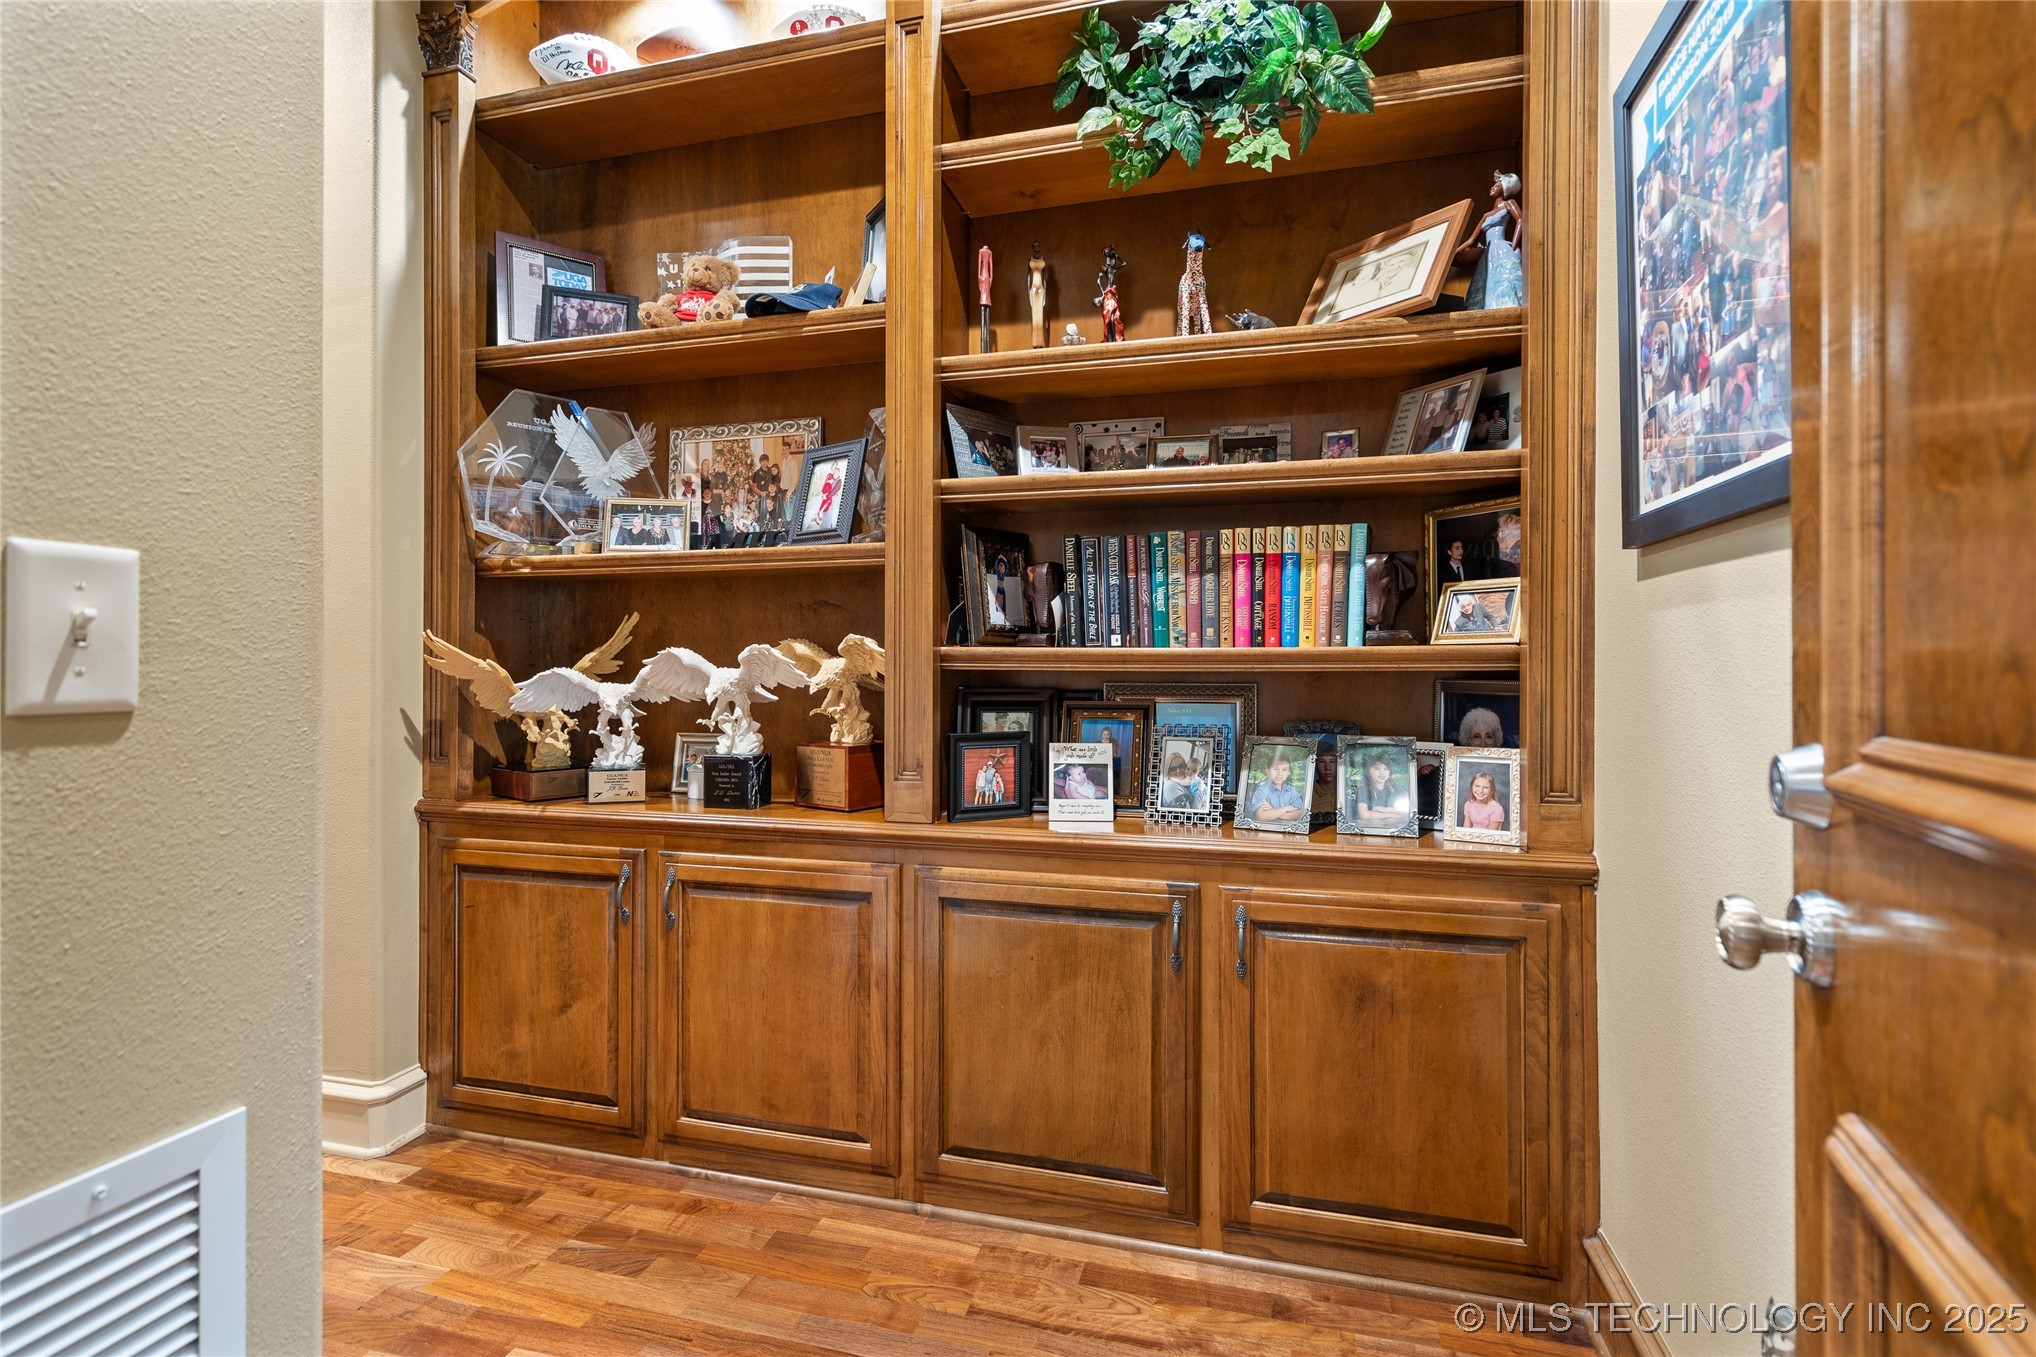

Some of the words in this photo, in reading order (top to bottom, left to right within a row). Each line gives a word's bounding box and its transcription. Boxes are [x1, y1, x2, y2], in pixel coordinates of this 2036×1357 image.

[1658, 44, 1687, 97] DANCE
[1665, 36, 1709, 110] BRANSON
[552, 278, 588, 290] TODAY
[564, 273, 587, 284] UGA
[1065, 537, 1075, 571] DANIELLE
[1086, 546, 1094, 559] ALL
[1108, 538, 1119, 555] WHEN
[1189, 538, 1198, 558] DANIELLE
[1205, 537, 1214, 555] DANIELLE
[1356, 529, 1366, 560] DANIELLE
[1087, 561, 1095, 572] THE
[1109, 556, 1119, 575] CRITICS
[1156, 547, 1164, 567] DANIELLE
[1189, 558, 1199, 573] STEEL
[1206, 556, 1214, 569] STEEL
[1286, 555, 1296, 577] DANIELLE
[1321, 555, 1331, 574] DANIELLE
[1156, 568, 1166, 583] STEEL
[1221, 557, 1231, 580] DANIELLE
[1237, 559, 1247, 582] DANIELLE
[1255, 557, 1264, 577] DANIELLE
[1269, 560, 1278, 580] DANIELLE
[1305, 558, 1315, 578] DANIELLE
[1335, 556, 1346, 580] DANIELLE
[1354, 563, 1364, 582] STEEL
[1066, 572, 1077, 593] STEEL
[1087, 574, 1095, 599] WOMEN
[1109, 576, 1119, 586] ASK
[1221, 580, 1231, 598] STEEL
[1237, 582, 1247, 599] STEEL
[1255, 576, 1264, 592] STEEL
[1286, 577, 1294, 593] STEEL
[1335, 579, 1345, 596] STEEL
[1321, 589, 1329, 605] SAFE
[1352, 590, 1363, 614] Family
[1088, 611, 1096, 622] THE
[1221, 600, 1231, 614] THE
[1254, 601, 1263, 630] COTTAGE
[1268, 603, 1277, 630] RANSOM
[1303, 596, 1313, 632] IMPOSSIBLE
[1334, 601, 1344, 628] ECHOES
[1222, 616, 1231, 633] KISS
[1319, 606, 1328, 633] HARBOUR
[1354, 616, 1363, 631] Ties
[1089, 623, 1097, 640] BIBLE
